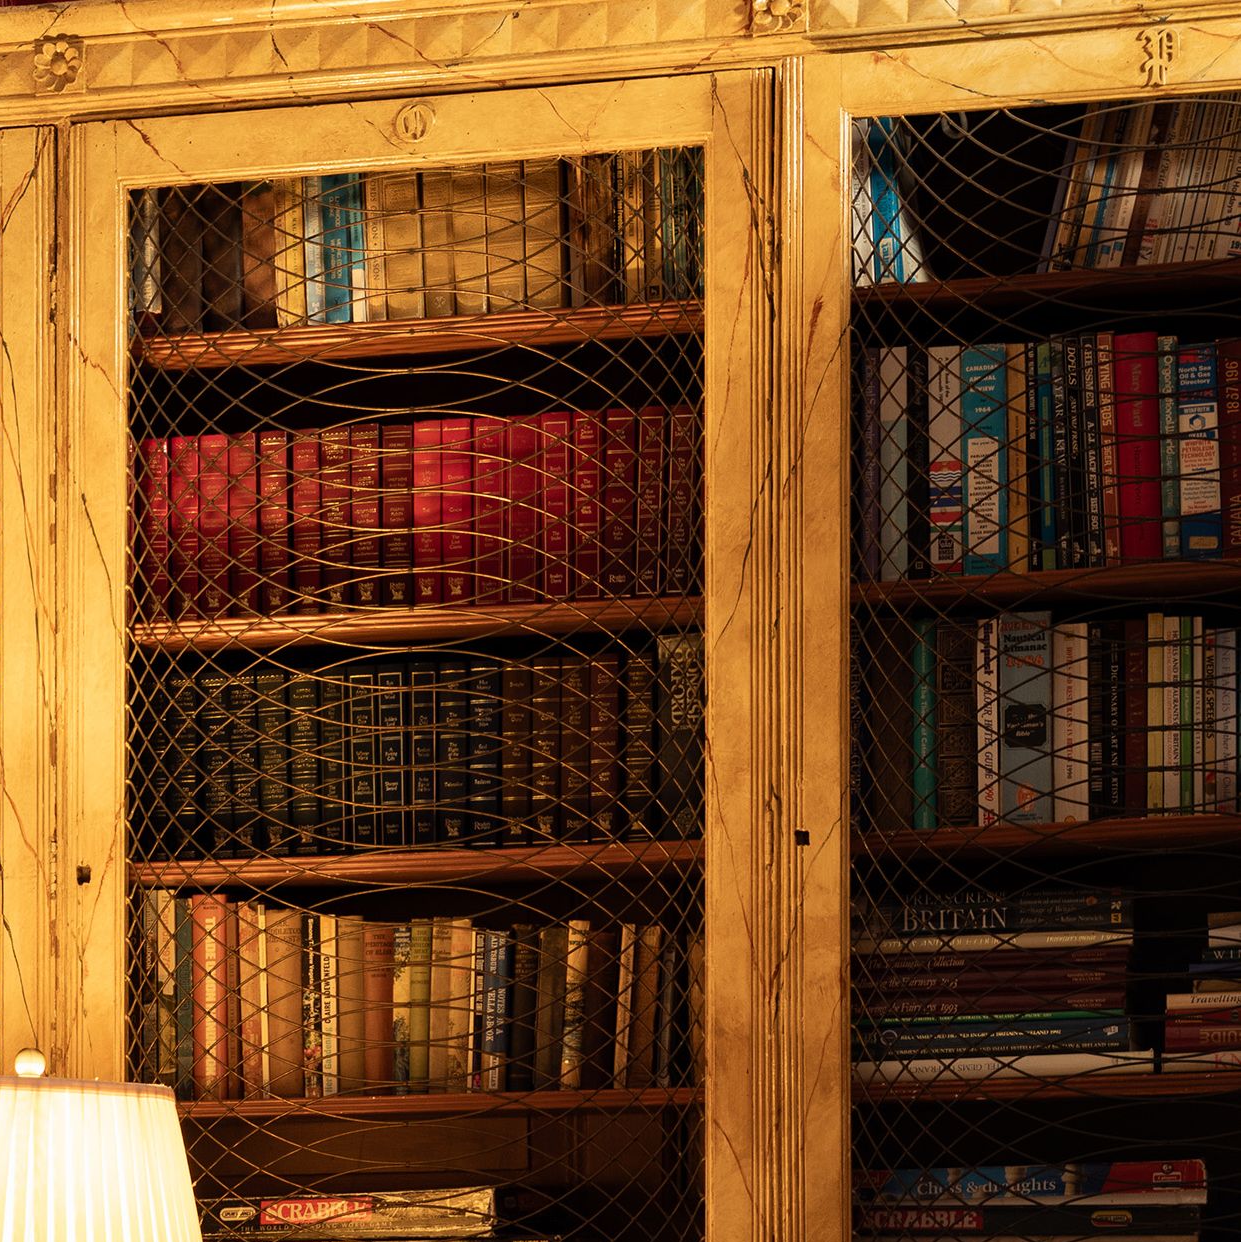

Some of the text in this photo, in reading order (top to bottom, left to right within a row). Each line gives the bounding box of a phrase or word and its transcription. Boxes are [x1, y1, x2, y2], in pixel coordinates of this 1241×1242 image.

[904, 908, 1008, 930] BRITAIN
[966, 1181, 979, 1193] &
[265, 1200, 367, 1222] SCRABBLE
[864, 1210, 977, 1228] SCRABBLE
